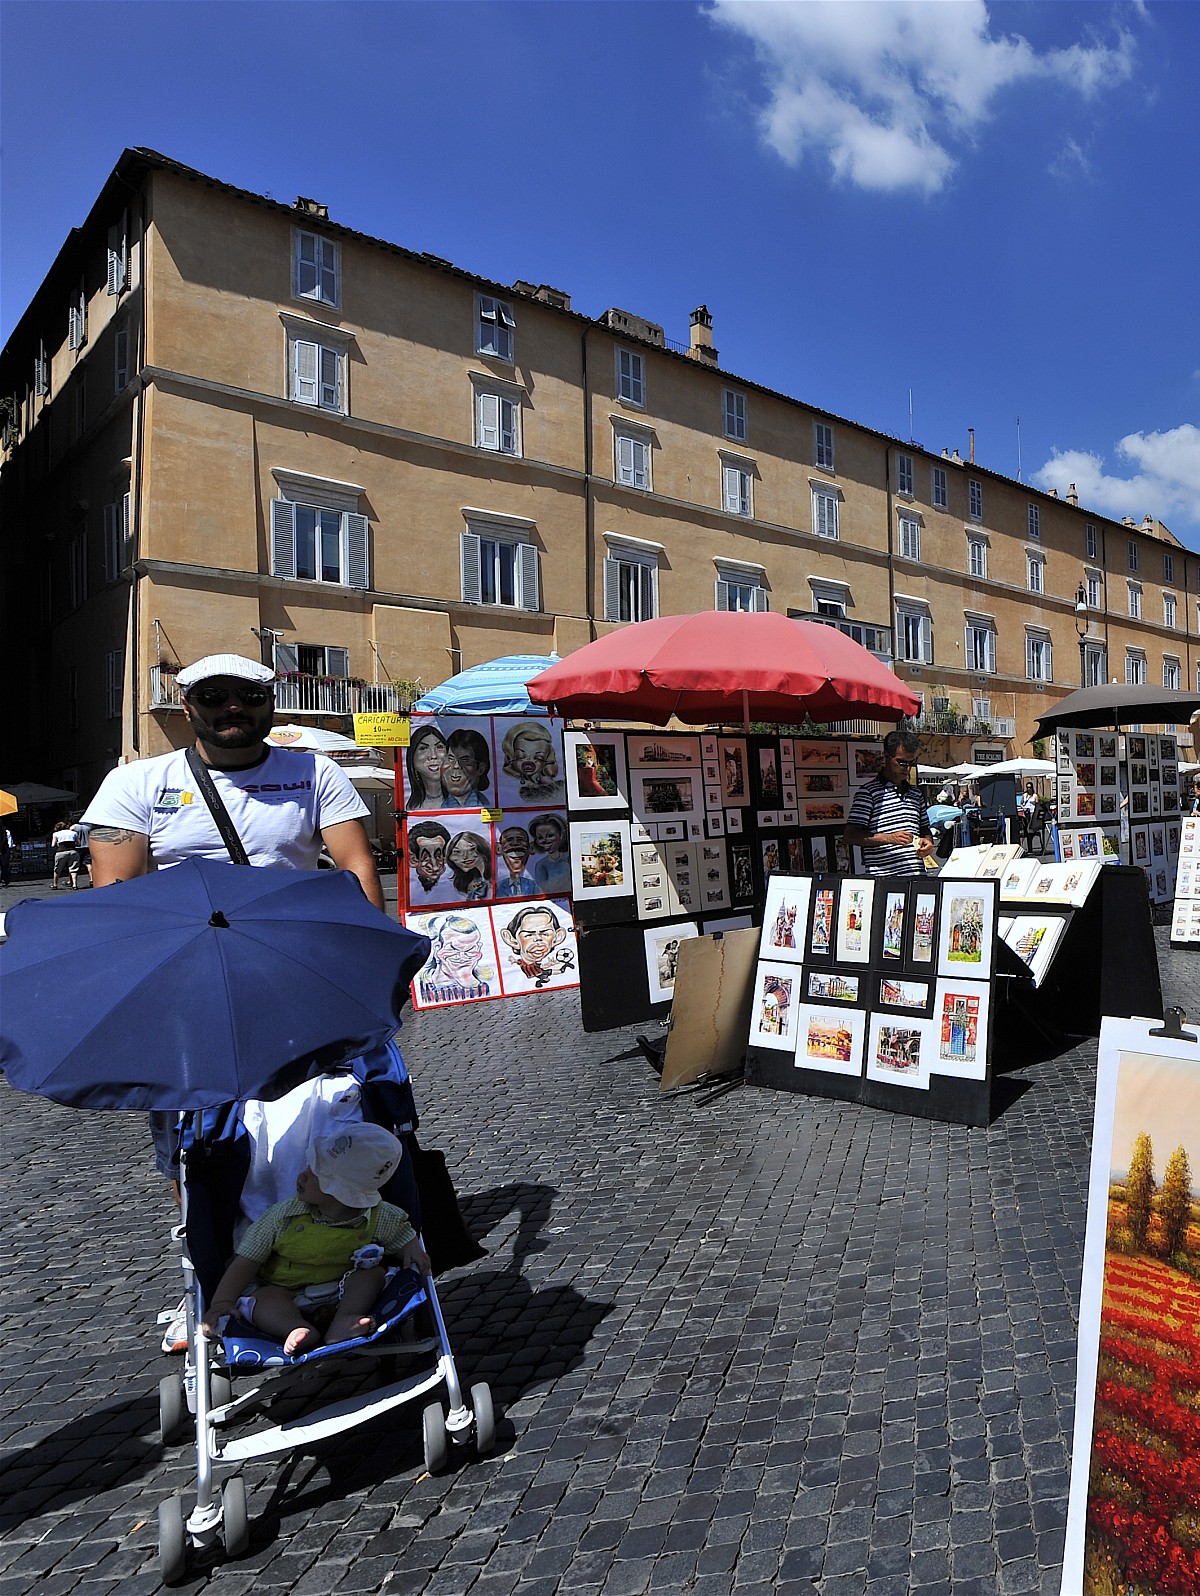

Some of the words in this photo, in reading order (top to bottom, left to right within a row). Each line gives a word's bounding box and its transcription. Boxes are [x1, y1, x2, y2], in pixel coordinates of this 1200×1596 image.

[357, 715, 407, 724] CARICATURA
[373, 725, 382, 733] 10
[224, 825, 245, 865] PIQUADR
